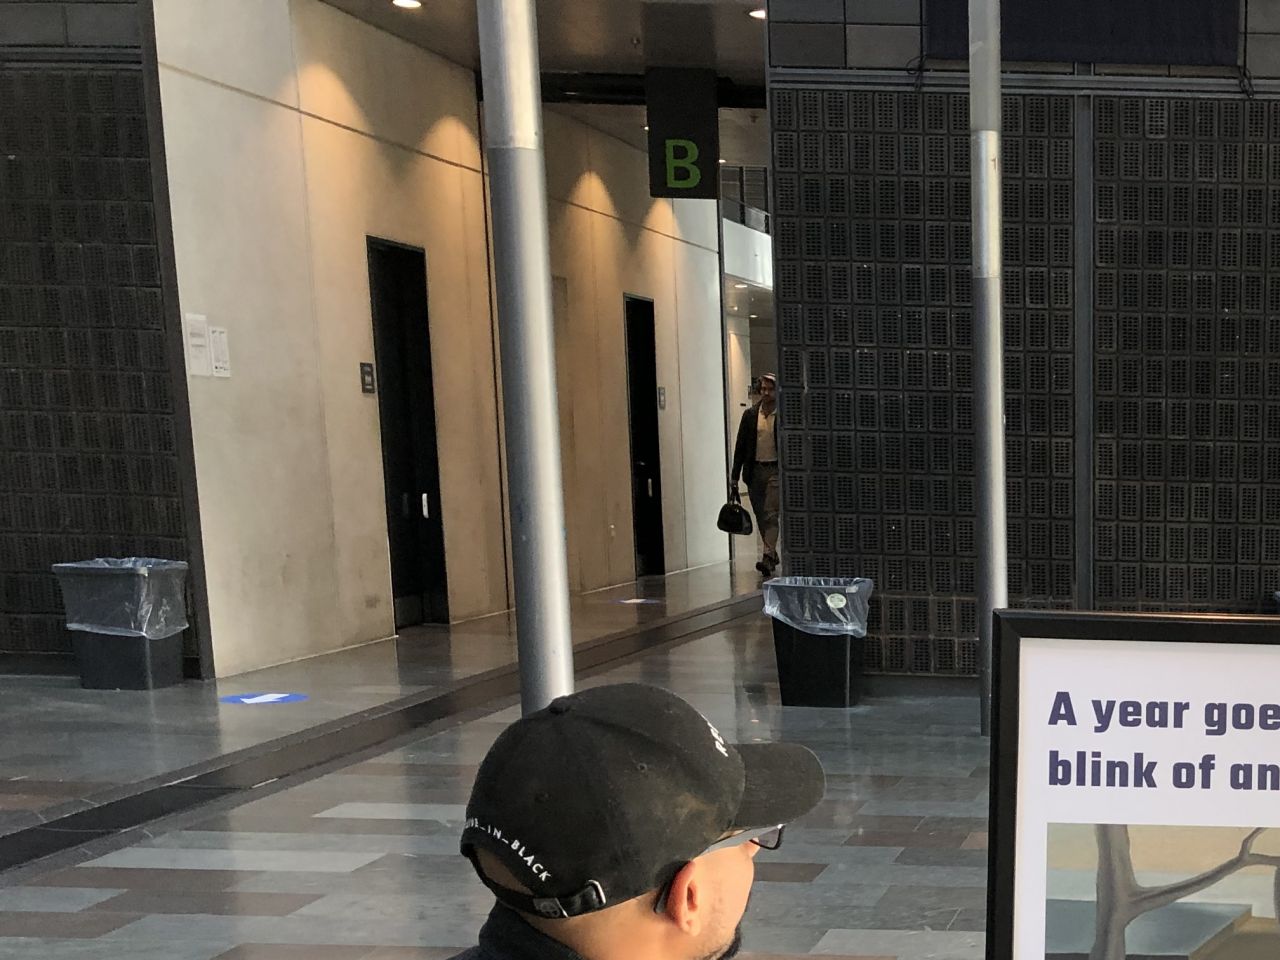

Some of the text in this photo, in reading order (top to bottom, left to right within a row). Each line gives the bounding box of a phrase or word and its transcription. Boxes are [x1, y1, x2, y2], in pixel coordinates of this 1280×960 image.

[665, 139, 701, 188] B
[1047, 691, 1078, 726] A
[1091, 699, 1190, 734] year
[1048, 750, 1158, 788] blink
[1172, 753, 1216, 790] of
[1229, 763, 1280, 791] an
